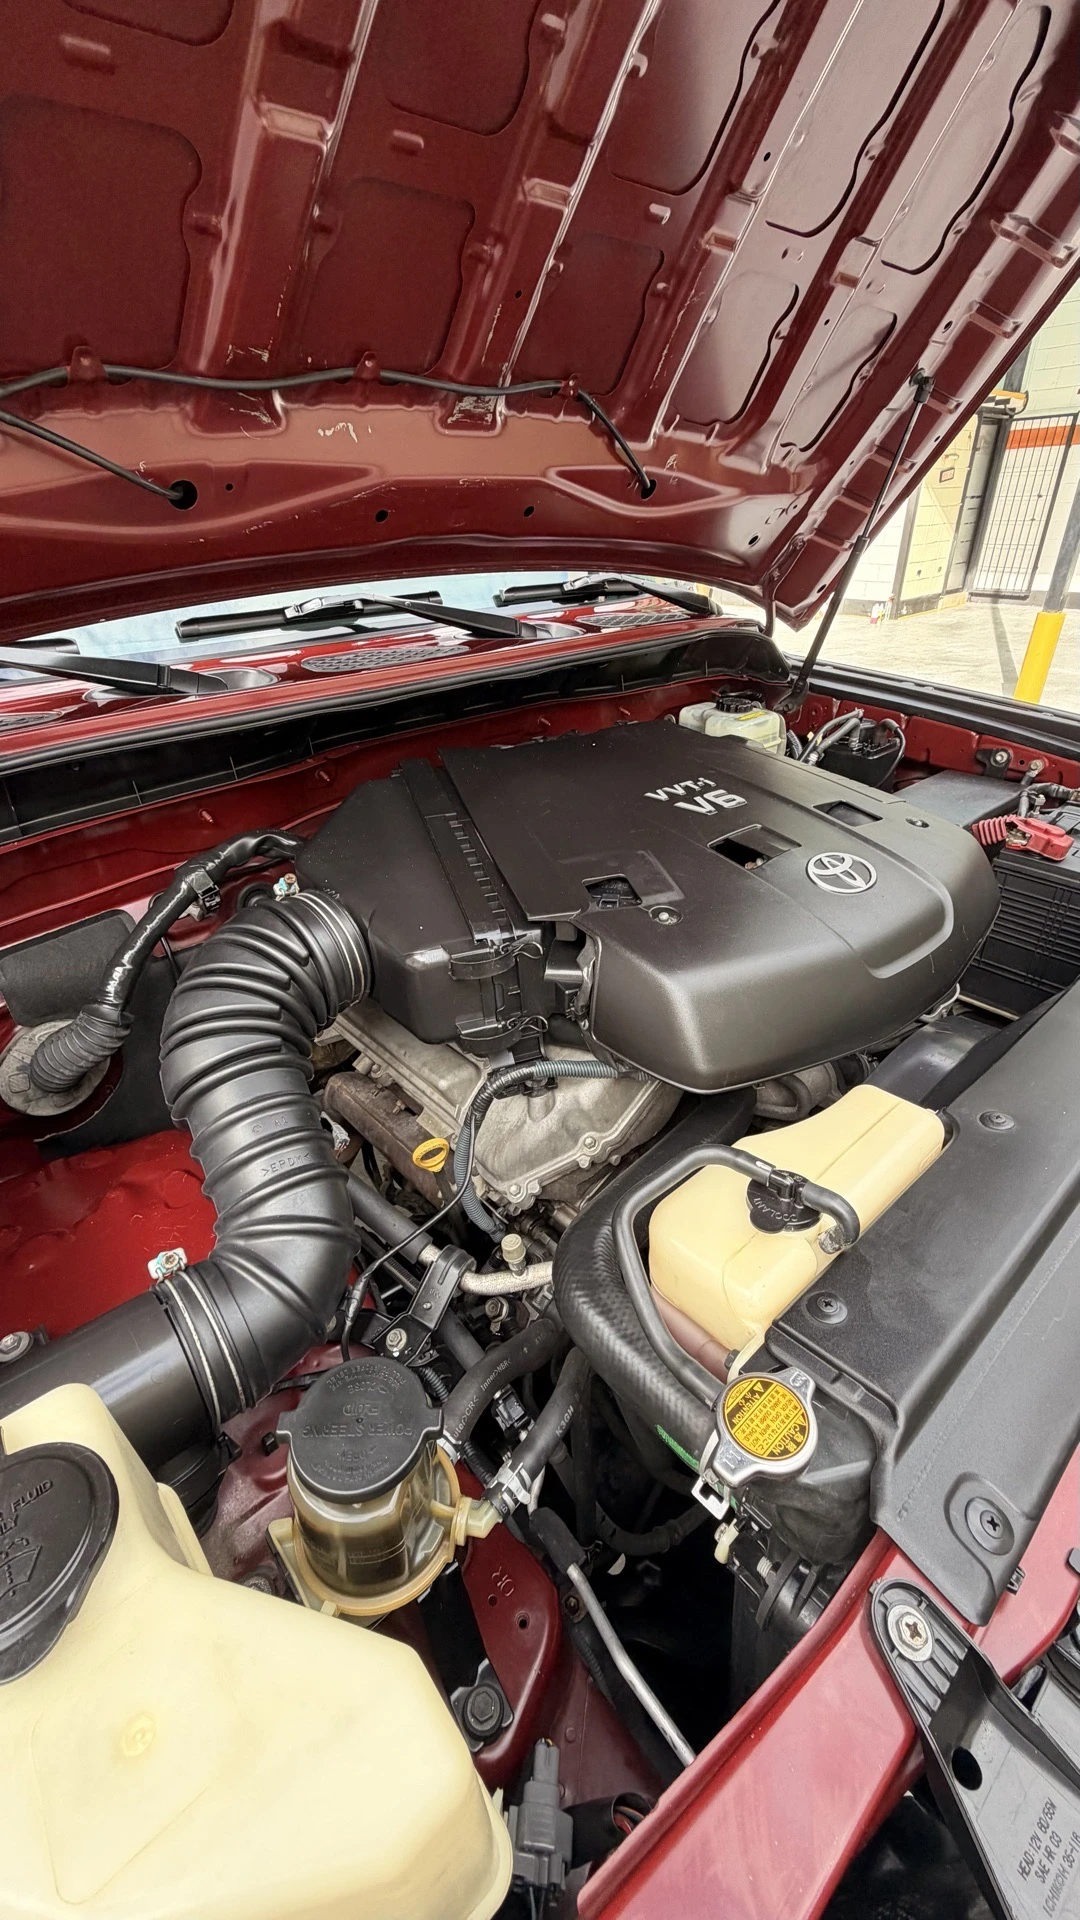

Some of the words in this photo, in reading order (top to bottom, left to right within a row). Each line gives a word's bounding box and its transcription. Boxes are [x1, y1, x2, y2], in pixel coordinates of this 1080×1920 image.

[674, 789, 747, 816] V6
[753, 1197, 798, 1222] COOLANT
[342, 1403, 379, 1416] FLUID
[731, 1392, 760, 1424] ATTENTION
[769, 1410, 782, 1423] OPEN
[301, 1423, 363, 1438] STEERING
[368, 1423, 412, 1436] POWER
[555, 1405, 574, 1438] K3GH
[758, 1423, 771, 1436] WHEN
[771, 1422, 800, 1455] CAUTION
[10, 1479, 53, 1514] FLUID
[1034, 1859, 1050, 1884] SAE
[1043, 1846, 1057, 1864] HR
